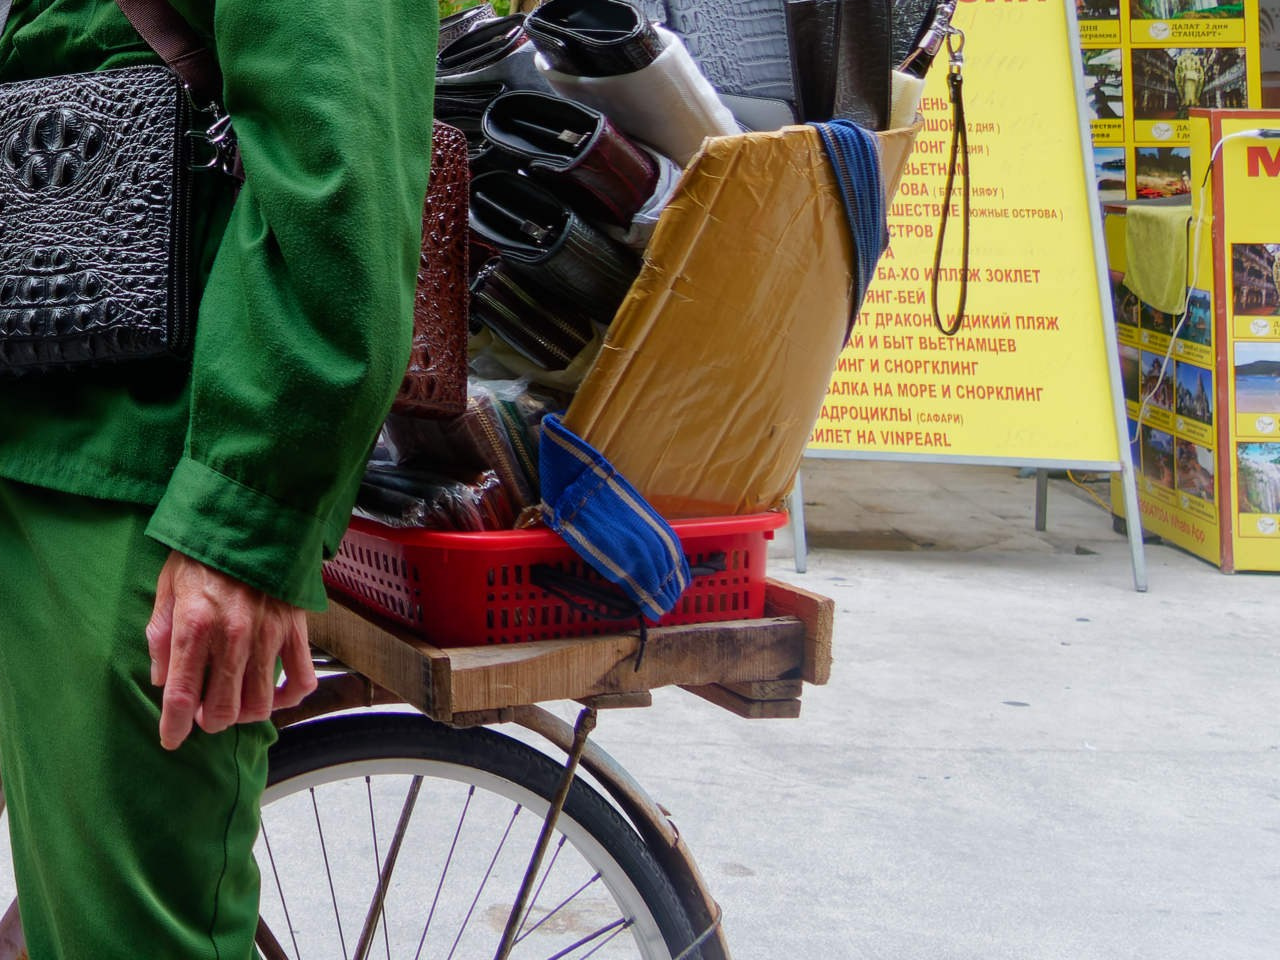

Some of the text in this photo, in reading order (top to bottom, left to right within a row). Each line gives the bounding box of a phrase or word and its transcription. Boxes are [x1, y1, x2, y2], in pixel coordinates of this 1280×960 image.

[903, 163, 965, 177] ВЬЕТНМ
[887, 203, 960, 218] ШЕСТВЕ
[888, 224, 934, 239] СТРОВ
[986, 269, 1041, 283] ЗОКЛЕТ
[875, 312, 936, 330] ДРАКОН
[1015, 315, 1060, 331] ПЛЯЖ
[883, 335, 914, 349] БЫТ
[919, 336, 1017, 355] ВЬЕТНАМЦЕВ
[833, 358, 865, 372] ИНГ
[873, 382, 893, 398] НА
[897, 383, 937, 398] МОРЕ
[955, 385, 1044, 402] СНОРКЛИНГ
[819, 405, 912, 423] АДРОЦИКЛЫ
[856, 430, 877, 445] НА
[879, 430, 952, 447] VINPEARL
